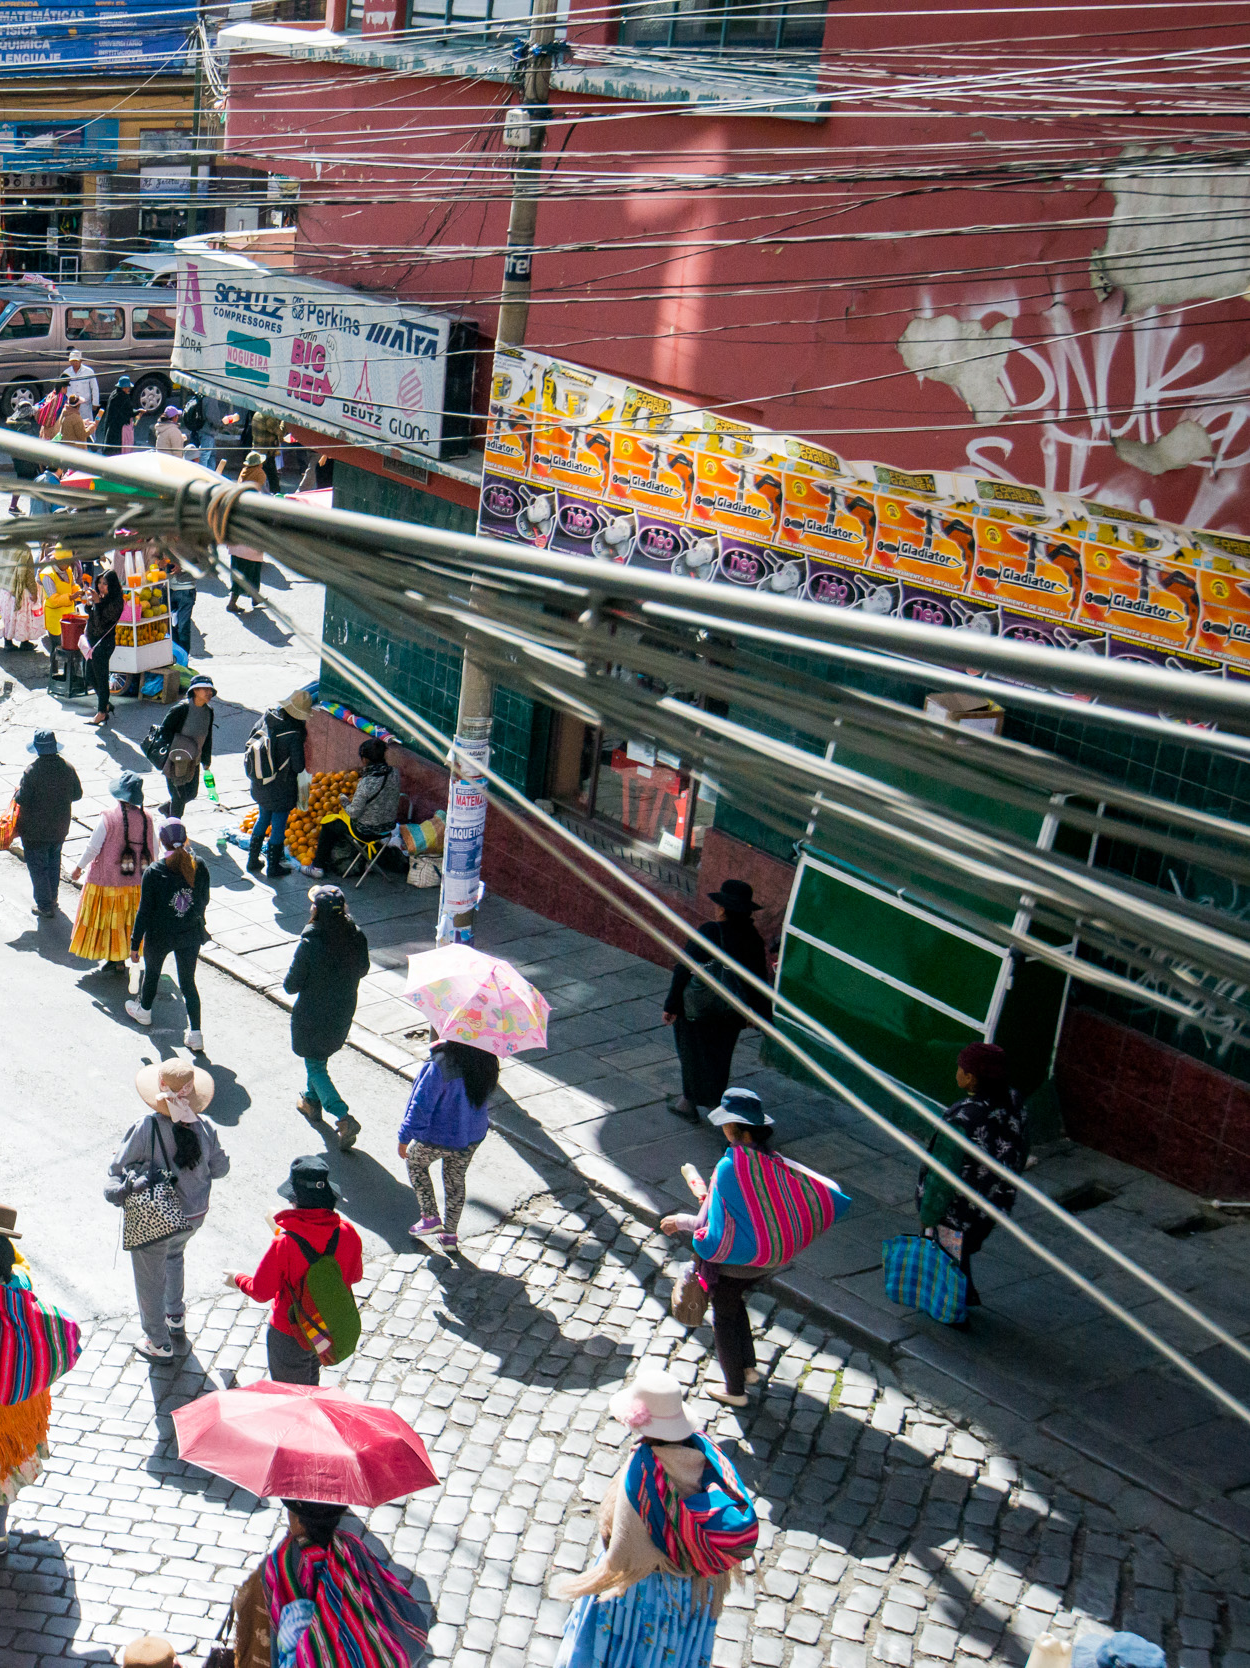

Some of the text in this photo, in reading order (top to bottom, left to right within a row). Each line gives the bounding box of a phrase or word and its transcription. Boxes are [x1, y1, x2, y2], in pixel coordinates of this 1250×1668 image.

[0, 8, 85, 22] MATEMÁTICAS
[214, 282, 287, 321] SCHULZ
[213, 306, 283, 334] COMPRESSORES
[307, 300, 361, 337] Perkins
[227, 346, 269, 373] NOGUEIRA
[291, 337, 326, 373] BIG
[287, 369, 332, 407] RED
[635, 400, 671, 415] GARDEN
[636, 392, 670, 408] FOREST
[342, 402, 383, 426] DEUTZ
[800, 443, 836, 460] FOREST
[800, 452, 839, 470] GARDEN
[552, 455, 592, 474] Gladiator
[631, 476, 674, 495] Gladiator
[889, 471, 930, 484] FOREST
[891, 479, 935, 491] GARDEN
[490, 489, 515, 507] neo
[993, 484, 1036, 497] FOREST
[995, 492, 1043, 505] GARDEN
[716, 497, 762, 517] Gladiator
[567, 509, 594, 528] neo
[569, 525, 588, 534] NEXT
[806, 519, 853, 540] Gladiator
[648, 531, 674, 551] neo
[647, 546, 668, 557] NEXT
[901, 542, 952, 564] Gladiator
[731, 552, 758, 574] neo
[819, 577, 848, 598] neo
[1002, 567, 1058, 591] Gladiator
[912, 602, 944, 626] neo
[1113, 594, 1172, 619] Gladiator
[1233, 623, 1250, 639] Gla
[456, 795, 485, 806] MATEMA
[450, 823, 485, 840] MAQUETIS
